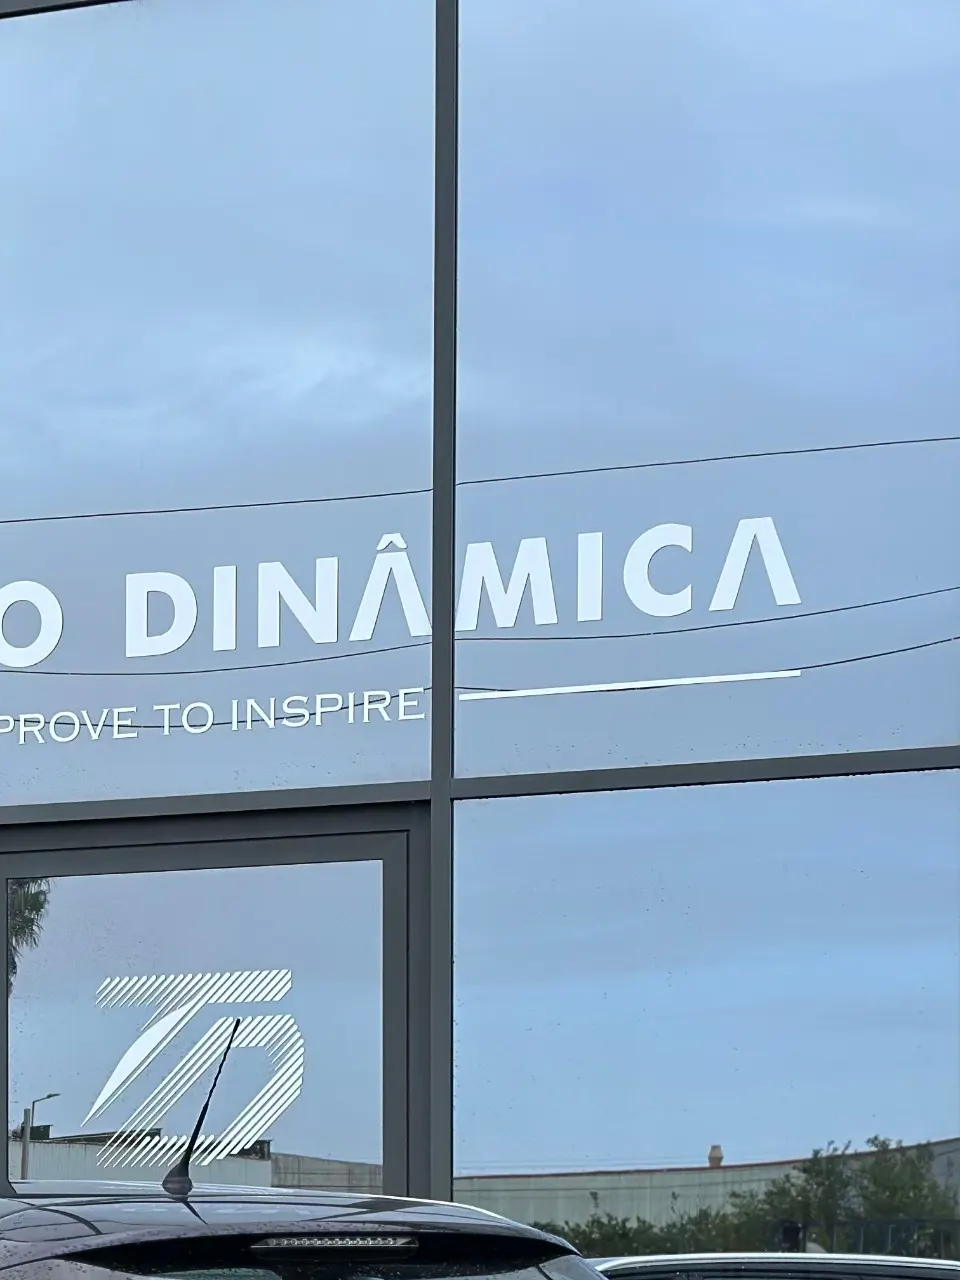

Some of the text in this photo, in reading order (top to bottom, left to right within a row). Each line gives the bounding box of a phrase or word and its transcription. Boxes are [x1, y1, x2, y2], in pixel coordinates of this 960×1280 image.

[125, 517, 802, 659] DINÂMICA
[153, 702, 214, 736] TO
[230, 687, 426, 731] INSPIRE
